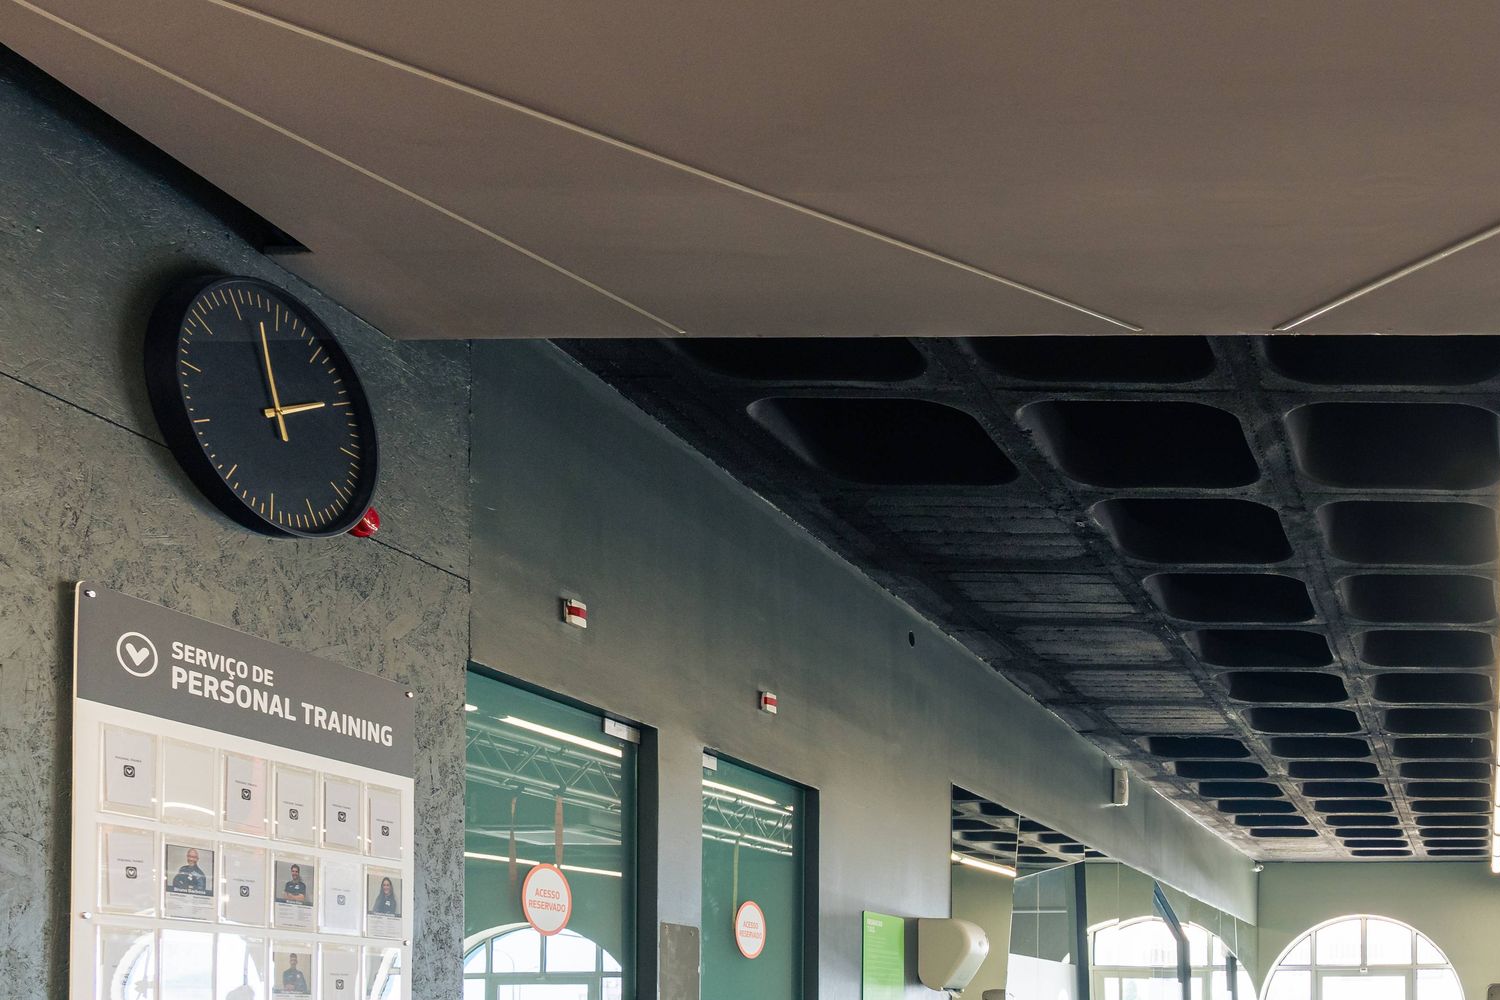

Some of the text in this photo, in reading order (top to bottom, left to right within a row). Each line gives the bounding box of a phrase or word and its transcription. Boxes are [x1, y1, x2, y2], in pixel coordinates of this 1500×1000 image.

[171, 641, 274, 687] SERVIÇO DE
[172, 666, 393, 747] PERSONAL TRAINING
[528, 899, 566, 912] RESERVADO
[534, 888, 561, 900] ACESSO
